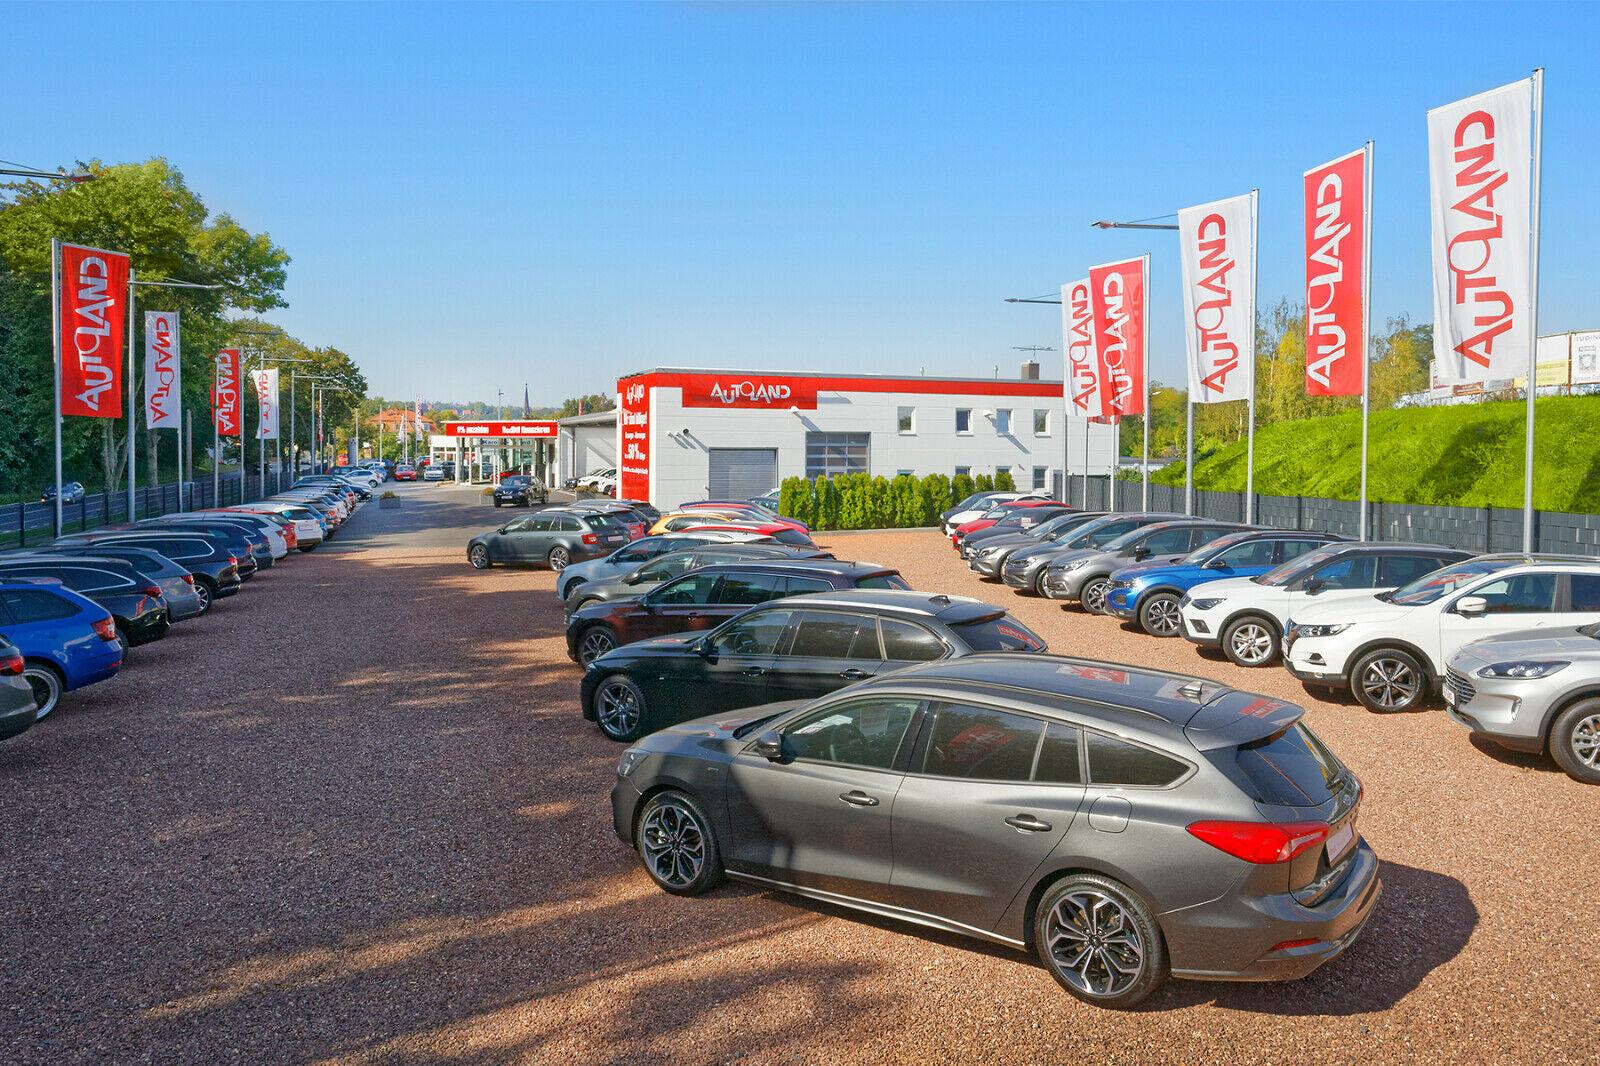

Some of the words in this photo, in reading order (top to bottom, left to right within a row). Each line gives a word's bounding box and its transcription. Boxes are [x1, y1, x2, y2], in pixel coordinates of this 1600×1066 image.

[1194, 212, 1239, 394] AUTOLAND
[1307, 172, 1351, 388] AUTOLAND
[1448, 109, 1514, 369] AUTOLAND
[74, 256, 115, 411] AUTOLAND
[710, 381, 791, 404] AUTOLAND
[1068, 283, 1097, 412] AUTOLAND
[1103, 271, 1133, 411] AUTOLAND
